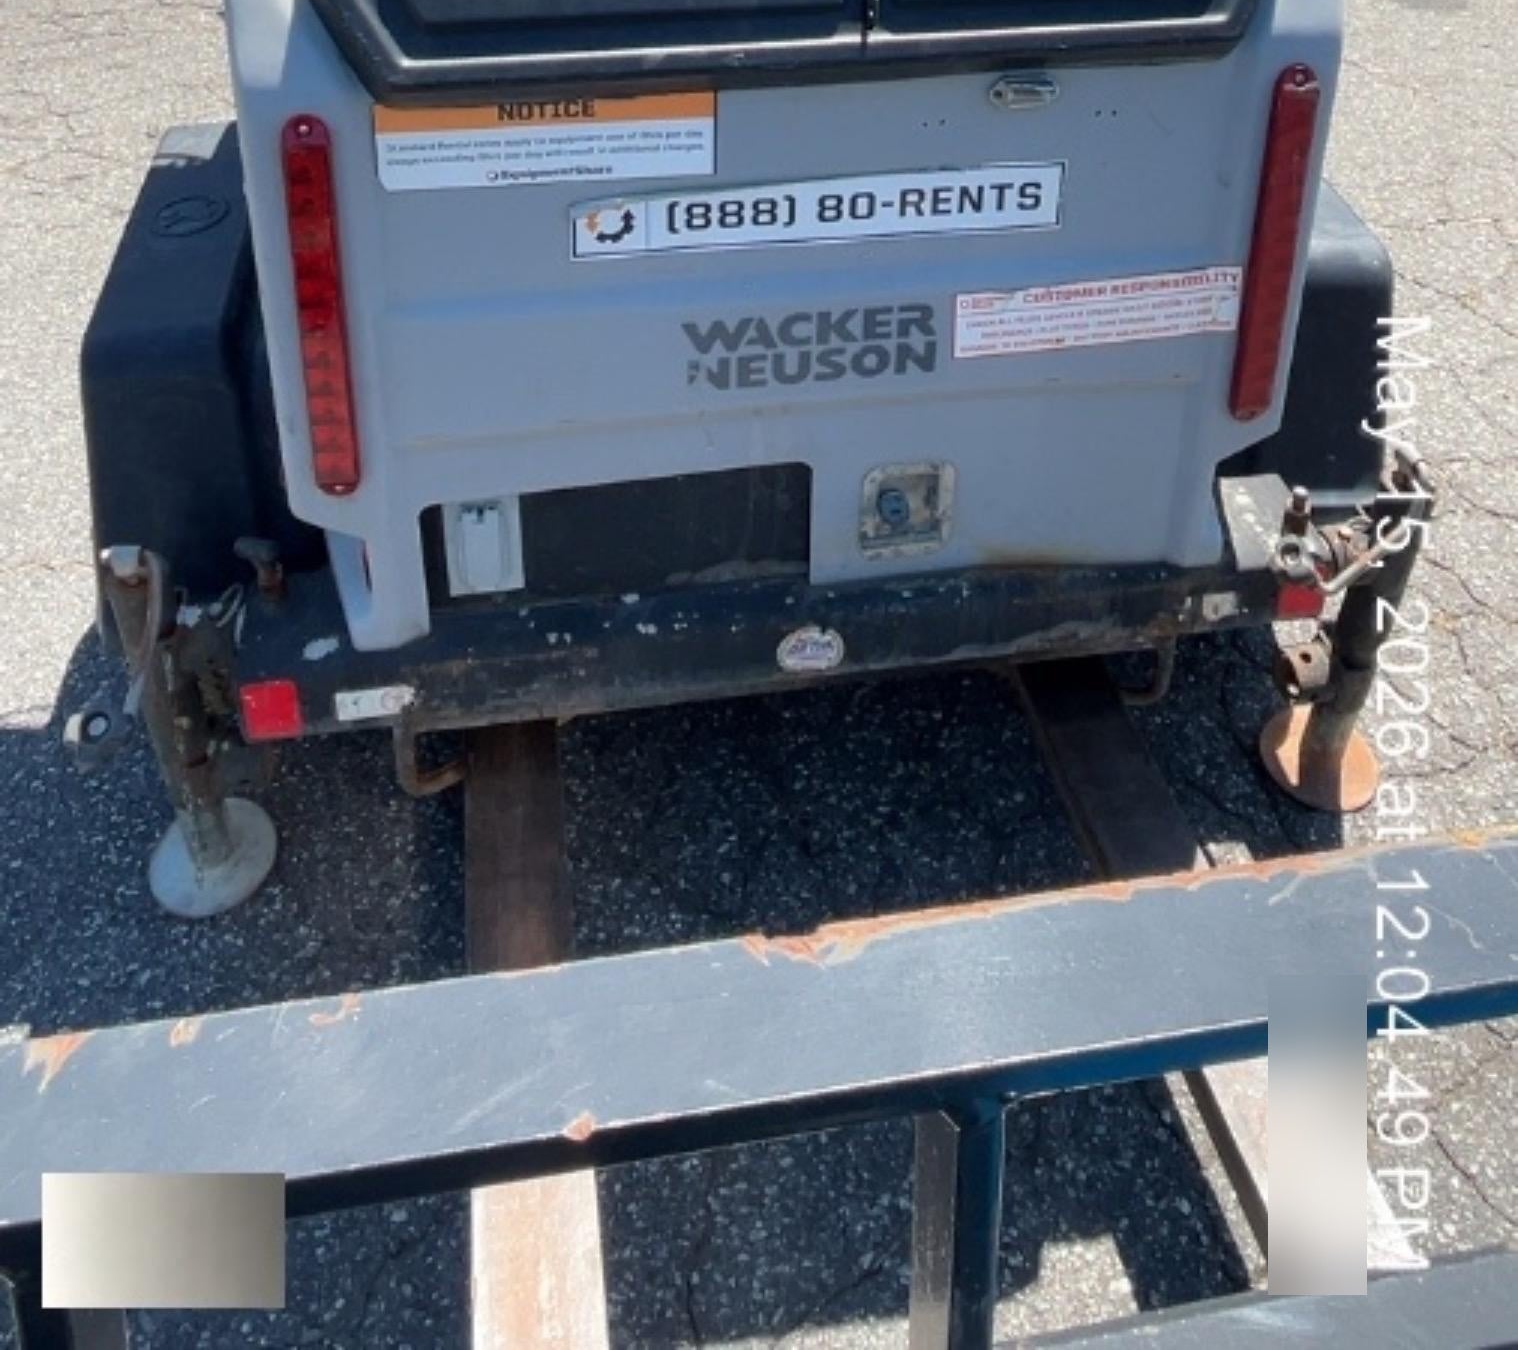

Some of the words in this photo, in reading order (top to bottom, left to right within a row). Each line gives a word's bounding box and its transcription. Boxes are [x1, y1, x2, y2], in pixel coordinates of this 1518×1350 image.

[497, 100, 597, 122] NOTICE
[666, 195, 797, 235] (888)
[816, 181, 1044, 223] 80-RENTS
[1022, 285, 1108, 304] CUSTOMER
[682, 303, 936, 353] WACKER
[686, 341, 937, 391] NEUSON
